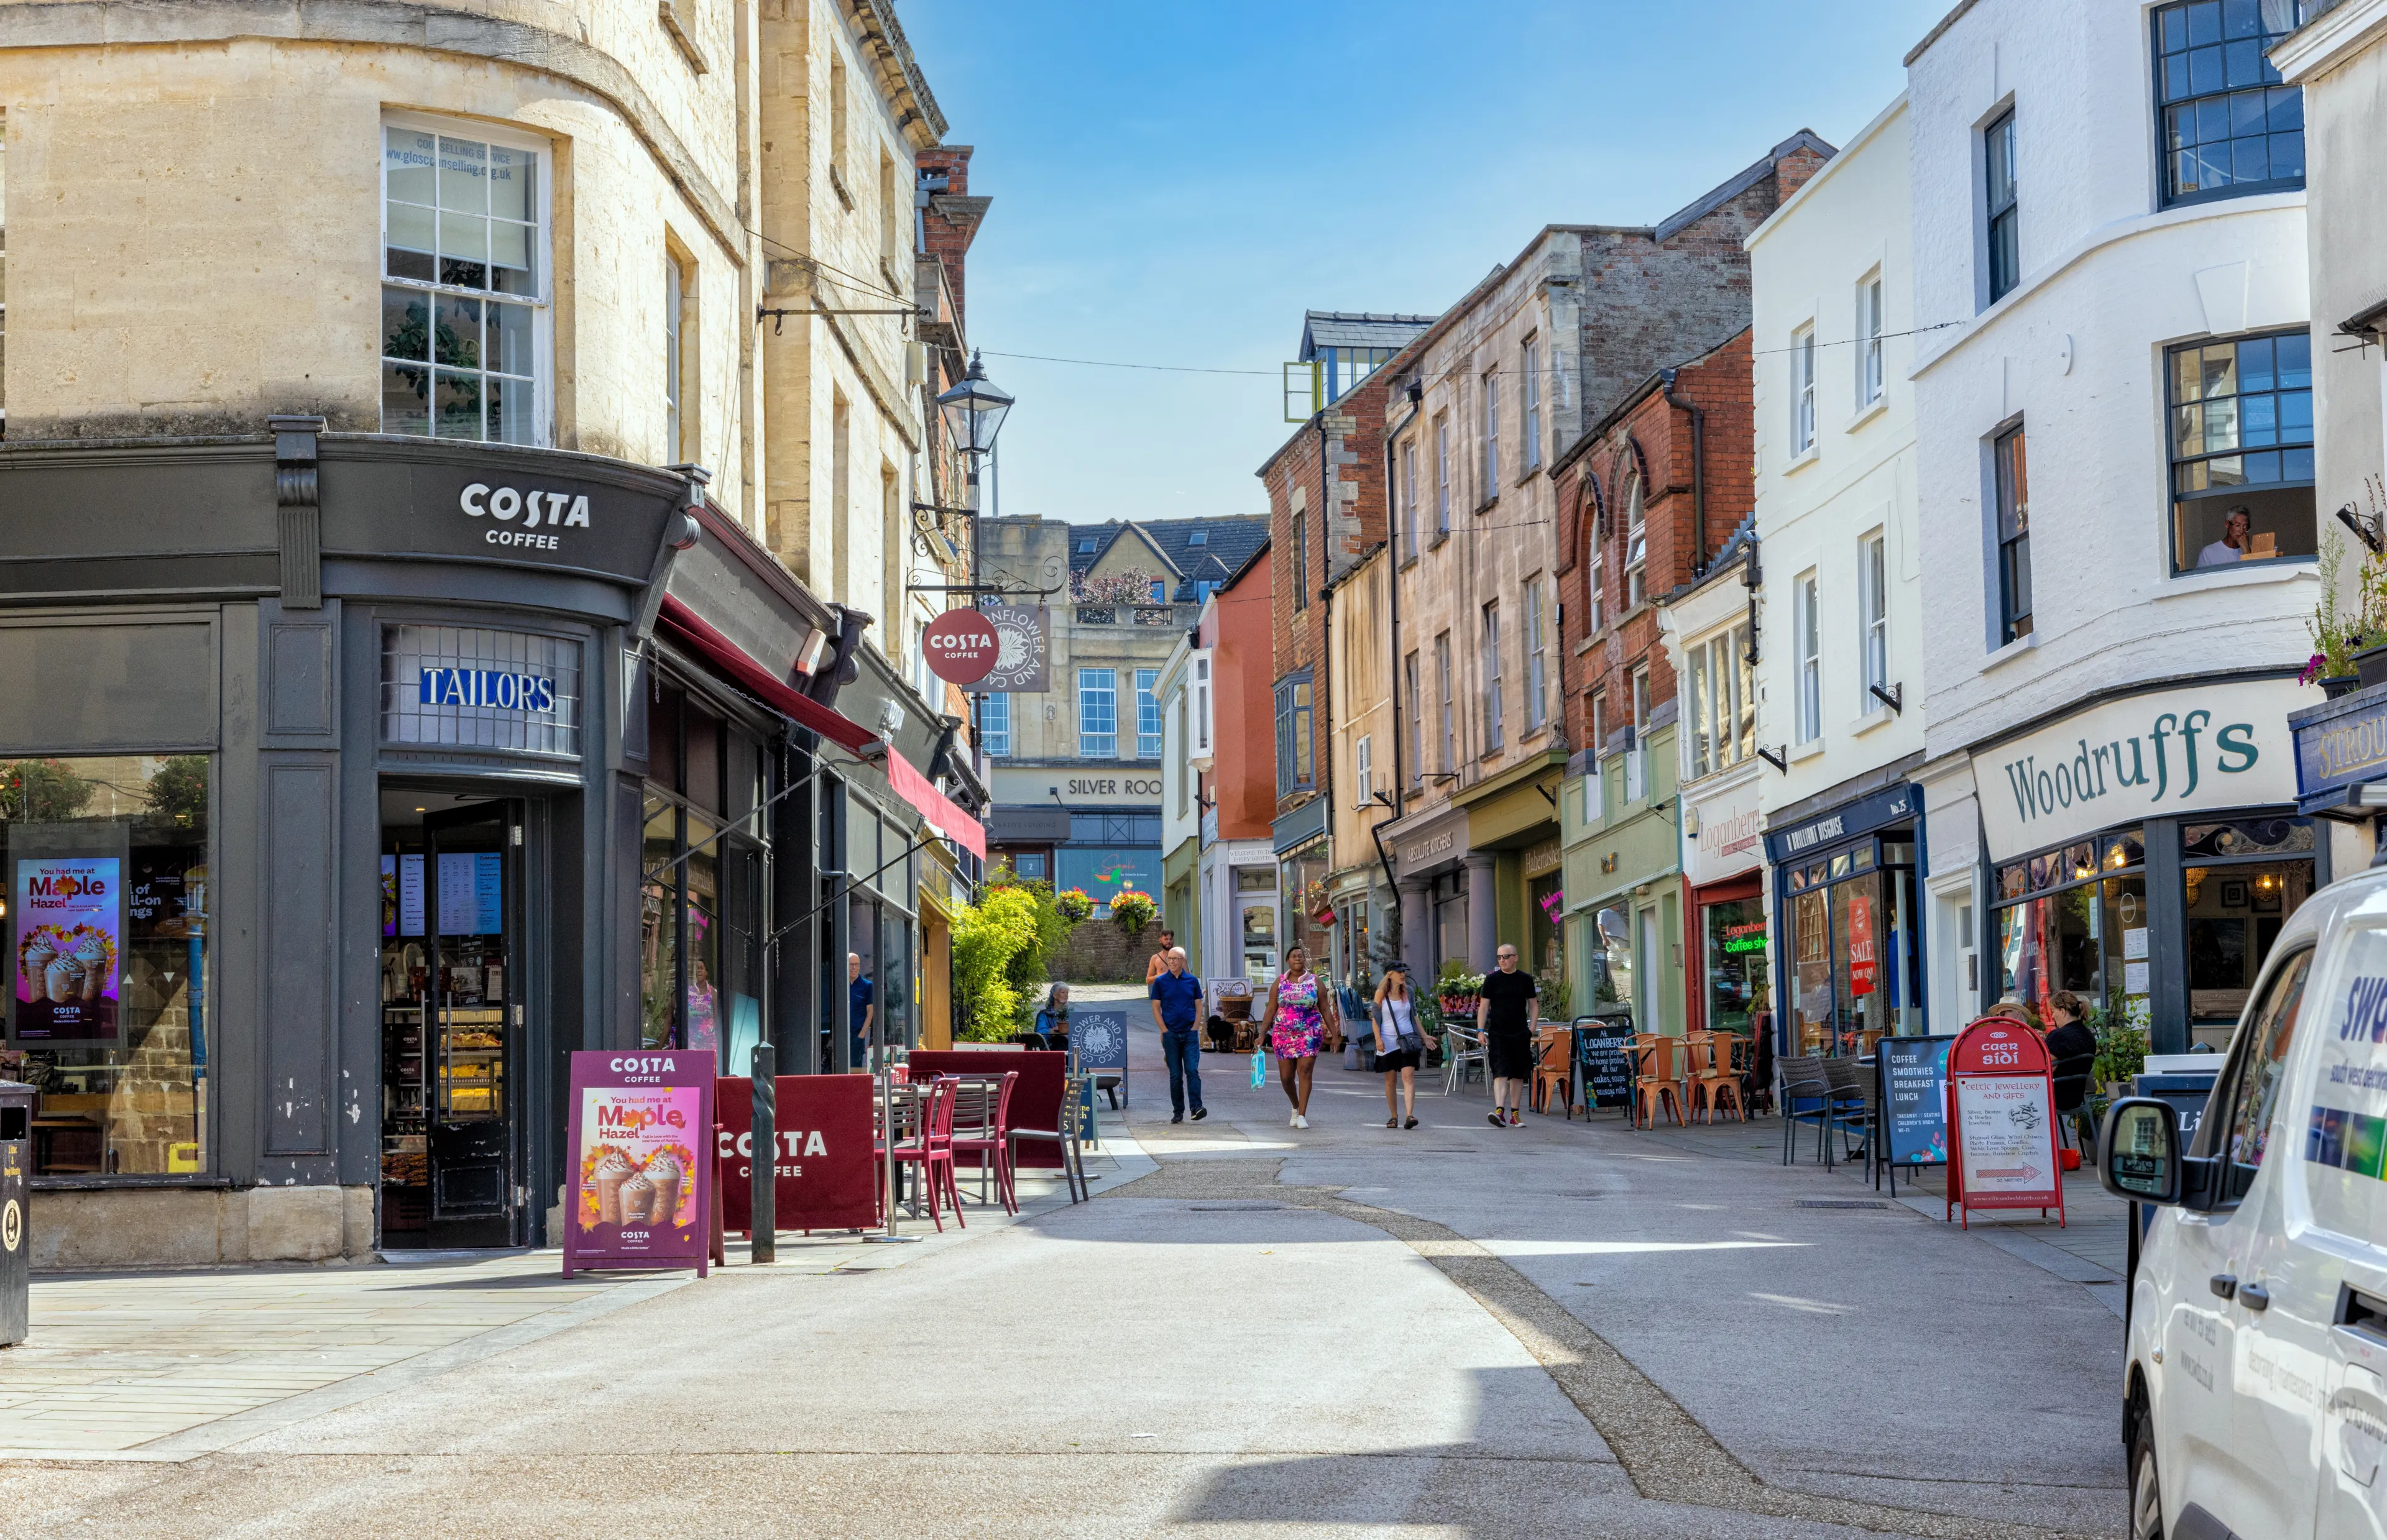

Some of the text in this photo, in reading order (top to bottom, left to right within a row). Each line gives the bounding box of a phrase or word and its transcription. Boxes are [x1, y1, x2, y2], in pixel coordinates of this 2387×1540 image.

[417, 138, 510, 164] COUSELLING SEVICE
[460, 483, 589, 528] COSTA
[485, 529, 559, 550] COFFEE
[931, 634, 992, 650] COSTA
[1014, 658, 1041, 685] AND
[423, 667, 554, 712] TAILORS
[2319, 716, 2386, 779] STROU
[2005, 709, 2260, 823] Woodruffs
[1069, 779, 1116, 795] SILVER
[1792, 825, 1819, 850] BRILLIANT
[1817, 815, 1844, 841] DISGUISE
[1407, 831, 1452, 864] ABSOLUTE KITCHENS
[1525, 841, 1562, 874] Haberdasher
[31, 897, 67, 909] Hazel
[1725, 939, 1754, 953] Coffee
[1851, 940, 1873, 964] SALE
[2025, 941, 2039, 958] CAKES
[1852, 969, 1864, 981] NOW
[53, 1007, 81, 1015] COSTA
[1103, 1017, 1121, 1035] AND
[610, 1058, 676, 1074] COSTA
[1595, 1057, 1608, 1065] home
[1892, 1055, 1918, 1063] COFFEE
[1594, 1074, 1626, 1084] cakes, soups
[1892, 1067, 1933, 1076] SMOOTHIES
[1596, 1086, 1626, 1097] sausage rolls
[1894, 1079, 1934, 1088] BREAKFAST
[1895, 1093, 1918, 1101] LUNCH
[598, 1104, 683, 1131] Mple
[599, 1127, 640, 1139] Hazel
[739, 1166, 802, 1177] CFEE
